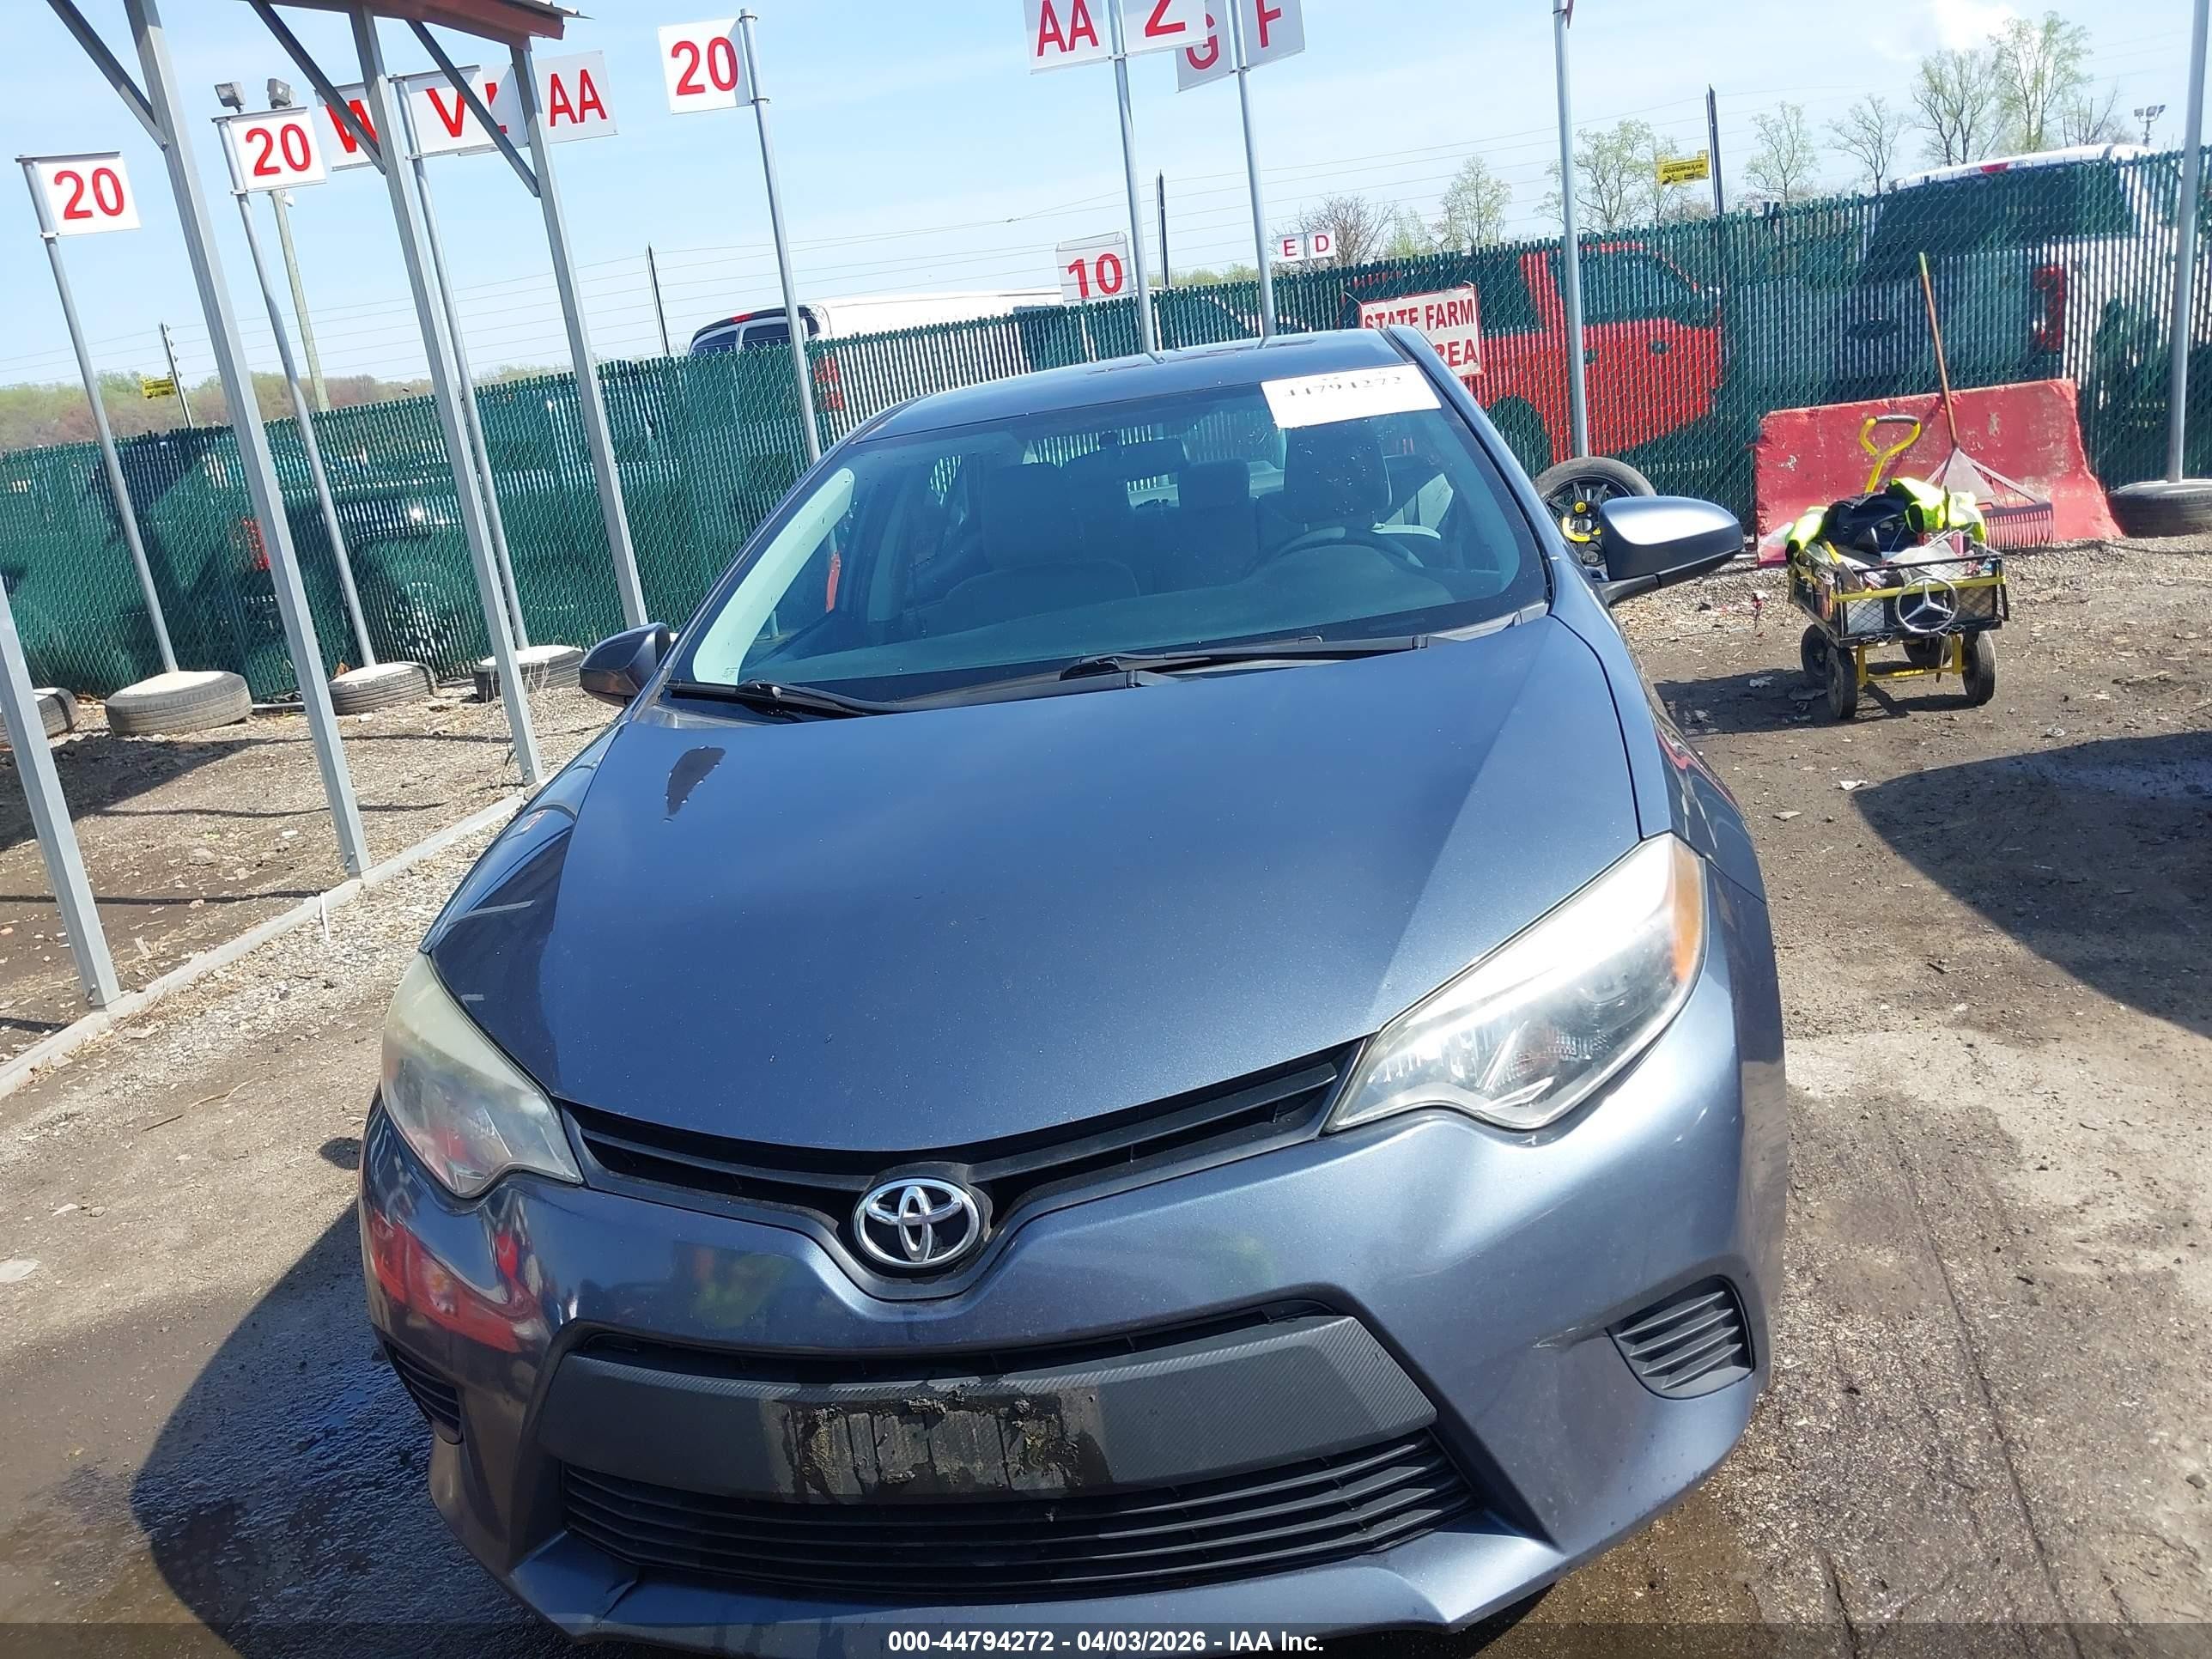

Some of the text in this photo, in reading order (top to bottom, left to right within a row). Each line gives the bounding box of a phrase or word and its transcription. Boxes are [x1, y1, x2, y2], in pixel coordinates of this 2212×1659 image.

[1037, 0, 1099, 57] AA
[672, 37, 737, 96] 20
[425, 88, 468, 138] V
[550, 69, 607, 126] AA
[246, 123, 312, 177] 20
[54, 167, 125, 221] 20
[1283, 238, 1297, 258] E
[1314, 234, 1329, 253] D
[1067, 252, 1123, 299] 10
[1425, 298, 1475, 331] FARM
